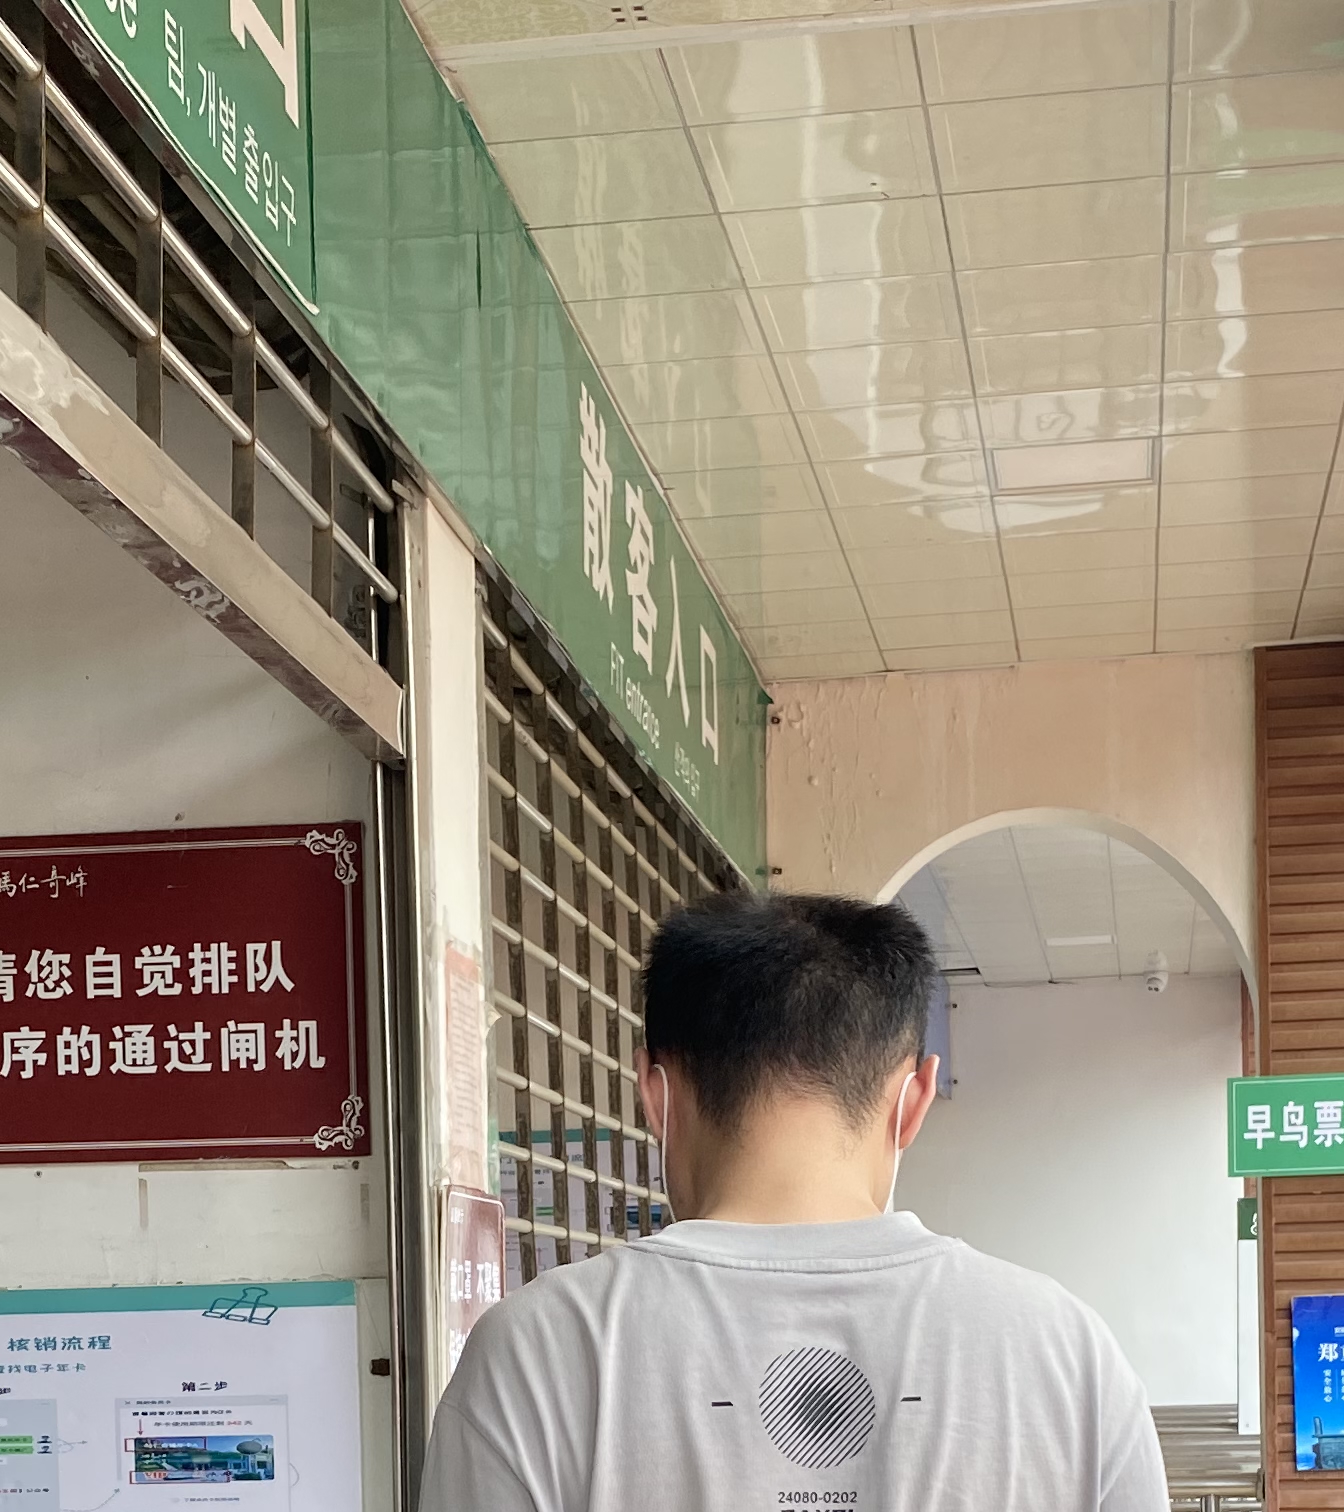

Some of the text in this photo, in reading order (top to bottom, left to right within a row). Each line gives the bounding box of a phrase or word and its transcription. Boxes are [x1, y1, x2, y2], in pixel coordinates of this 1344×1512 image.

[198, 63, 238, 175] 개별
[243, 123, 298, 247] 출입구
[578, 379, 720, 767] 散客入口
[7, 1335, 113, 1352] 核销流程
[182, 1381, 228, 1392] 第二步
[778, 1491, 858, 1504] 24080-0202
